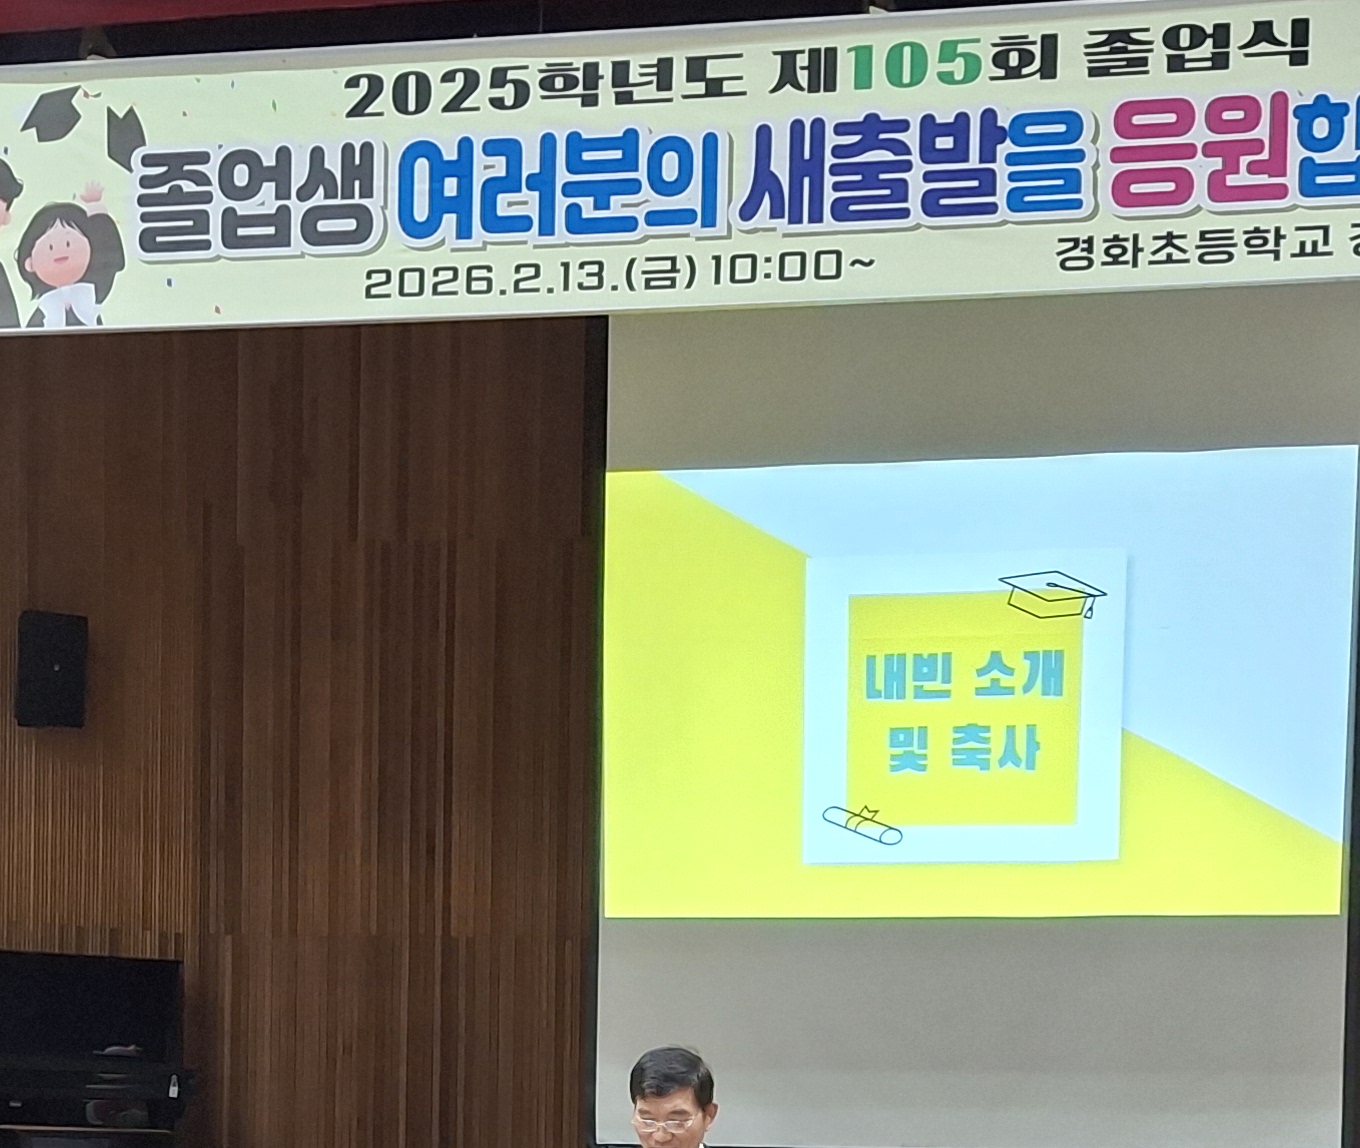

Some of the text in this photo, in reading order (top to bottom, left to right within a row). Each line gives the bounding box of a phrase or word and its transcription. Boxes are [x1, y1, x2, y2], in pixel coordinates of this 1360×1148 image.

[344, 17, 1311, 118] 2025학년도 제105회 졸업식
[135, 138, 378, 255] 졸업생
[397, 126, 720, 242] 여러분의
[738, 107, 1087, 225] 새출발을
[1054, 224, 1335, 272] 경화초등학교
[363, 248, 876, 300] 2026.2.13.(금) 10:00~
[865, 649, 1066, 700] 내빈 소개
[887, 723, 1041, 773] 및 축사
